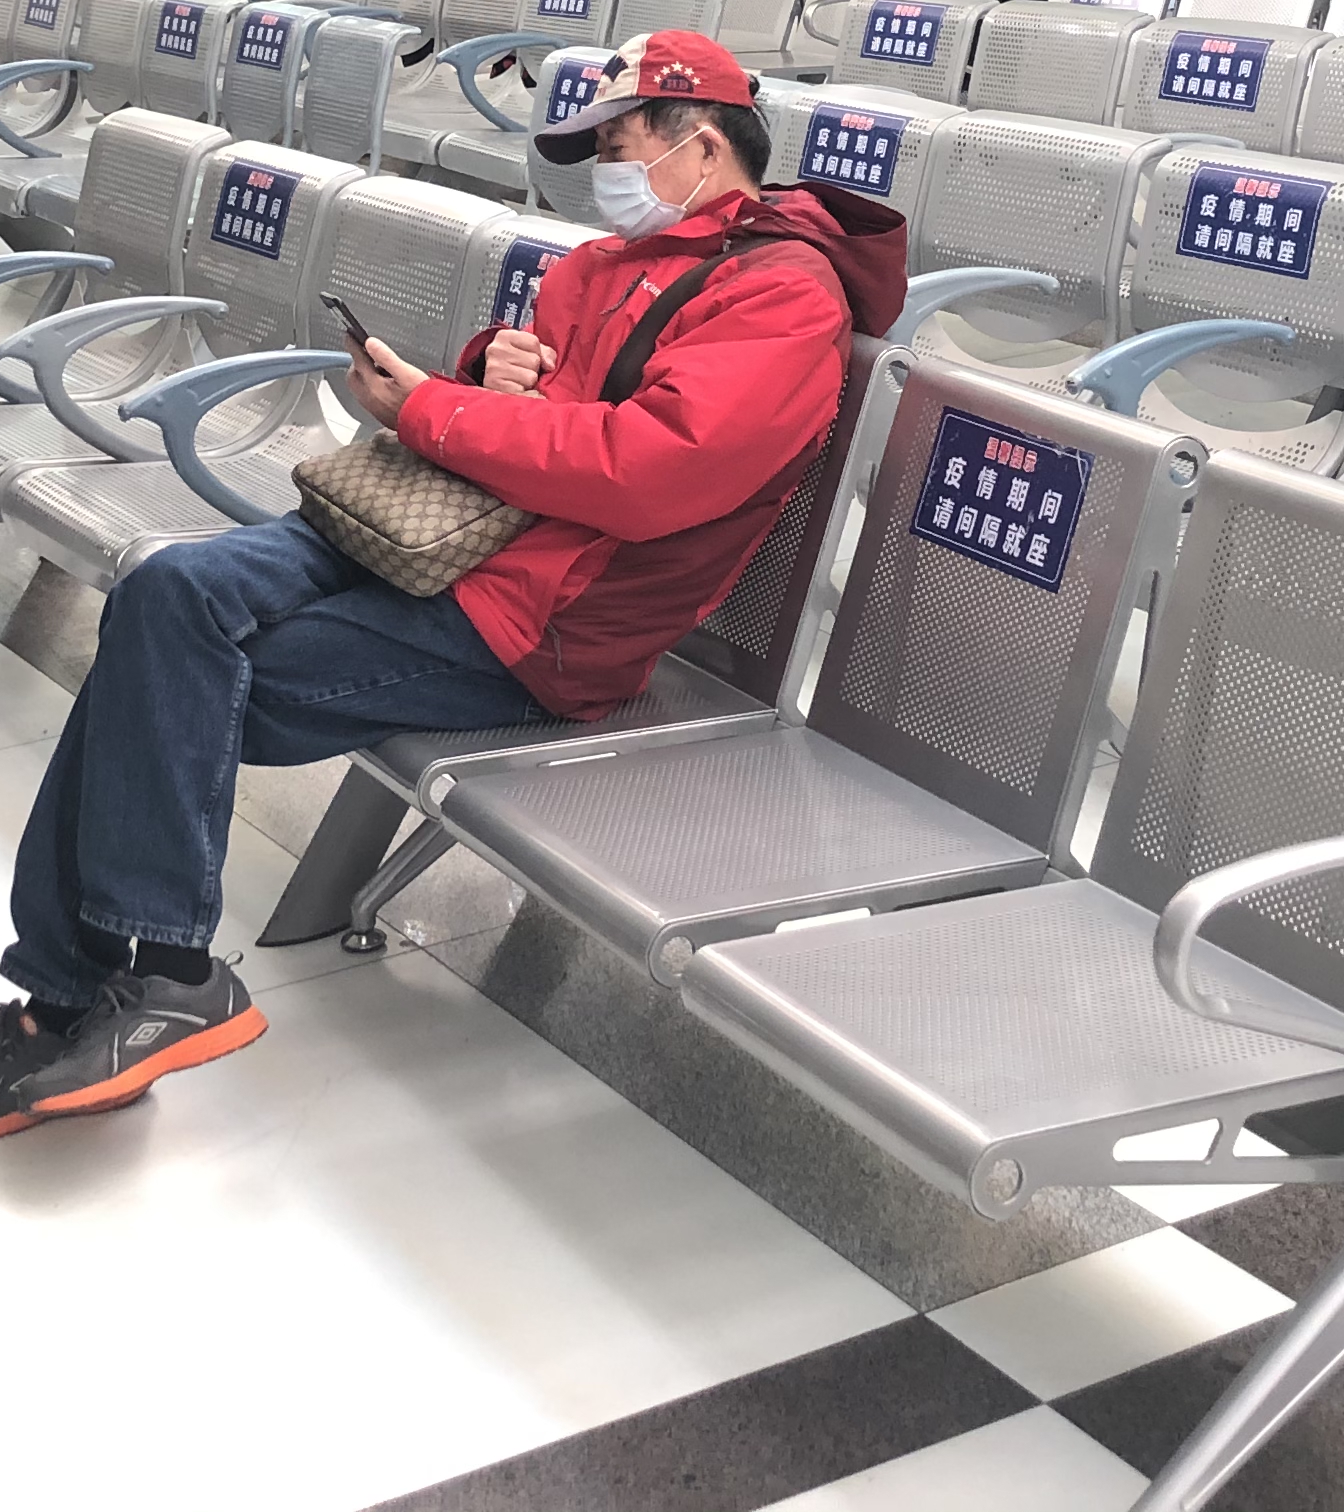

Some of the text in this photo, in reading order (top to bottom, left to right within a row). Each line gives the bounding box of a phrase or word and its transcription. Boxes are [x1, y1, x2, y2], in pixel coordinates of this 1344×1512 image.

[1200, 194, 1303, 232] 疫情期间
[1195, 224, 1296, 264] 请间隔就座
[944, 456, 1062, 524] 疫情期间
[932, 496, 1050, 567] 请间隔就座
